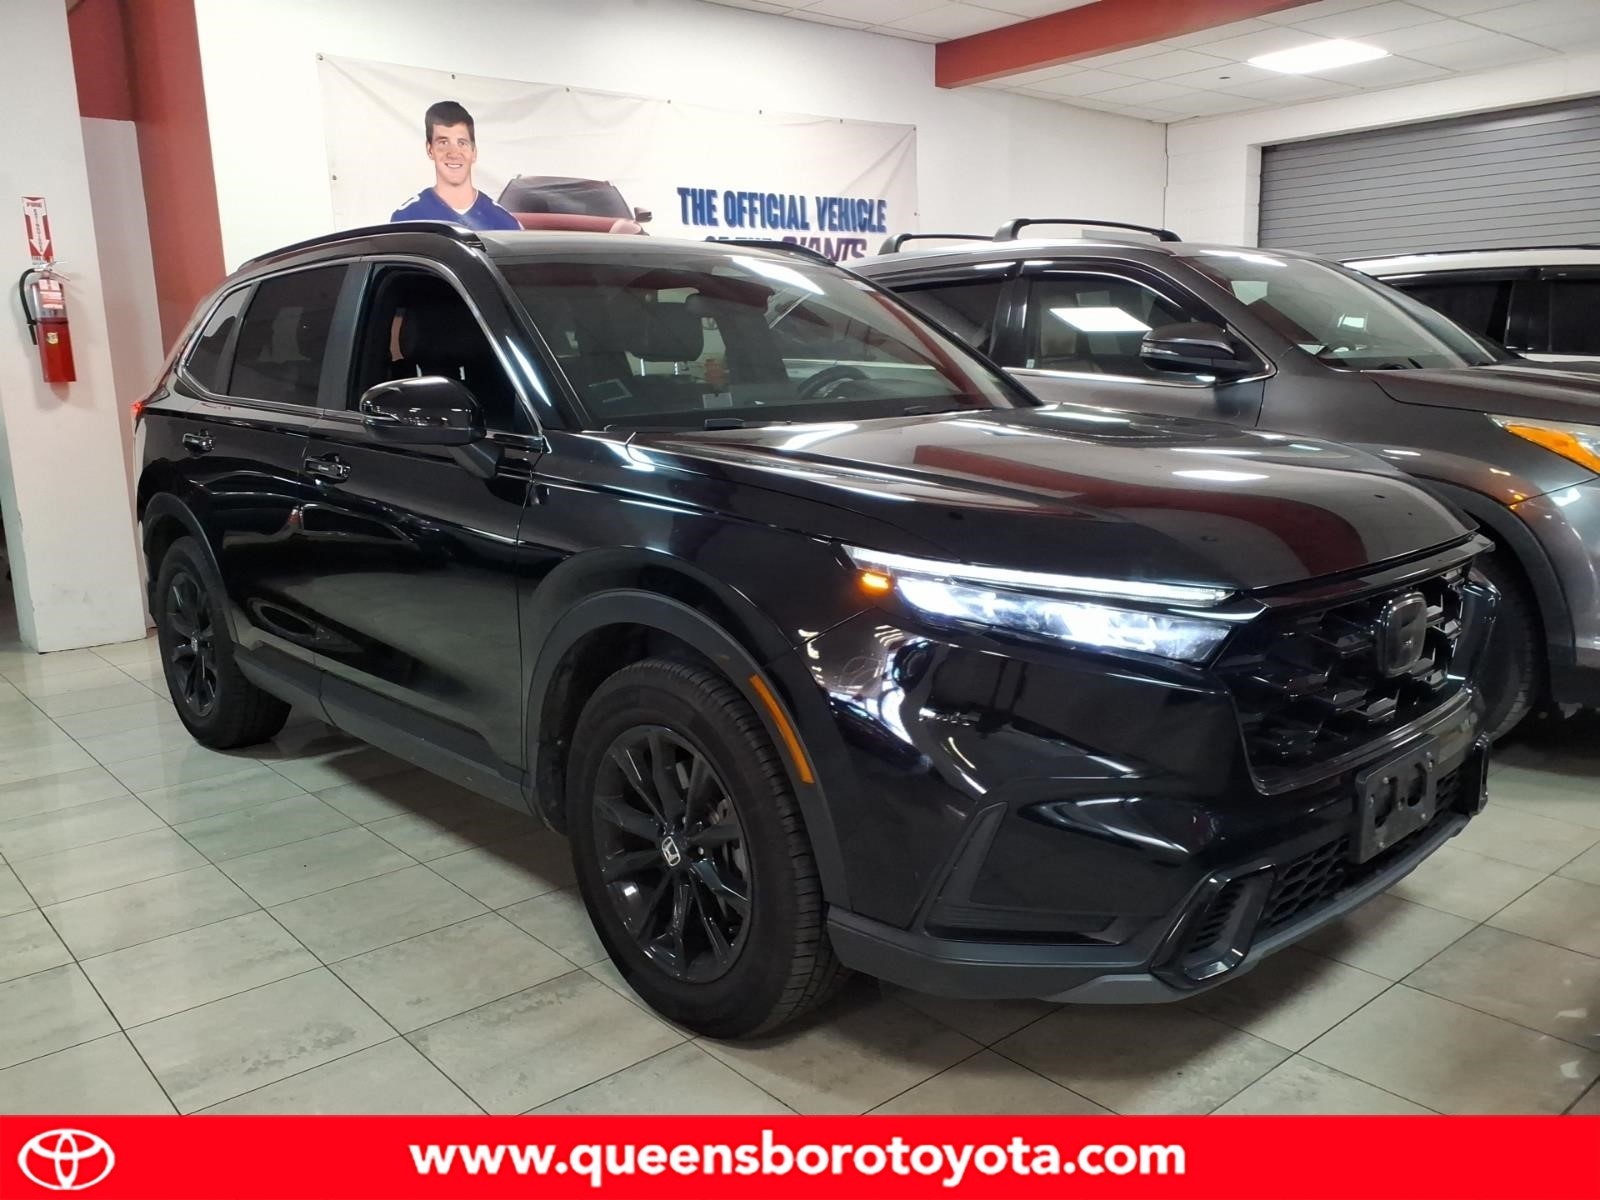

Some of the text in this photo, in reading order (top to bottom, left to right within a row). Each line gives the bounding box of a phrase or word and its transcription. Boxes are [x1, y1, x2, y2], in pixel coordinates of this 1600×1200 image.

[677, 187, 887, 233] THE OFFICIAL VEHICLE
[782, 236, 867, 263] ANTS
